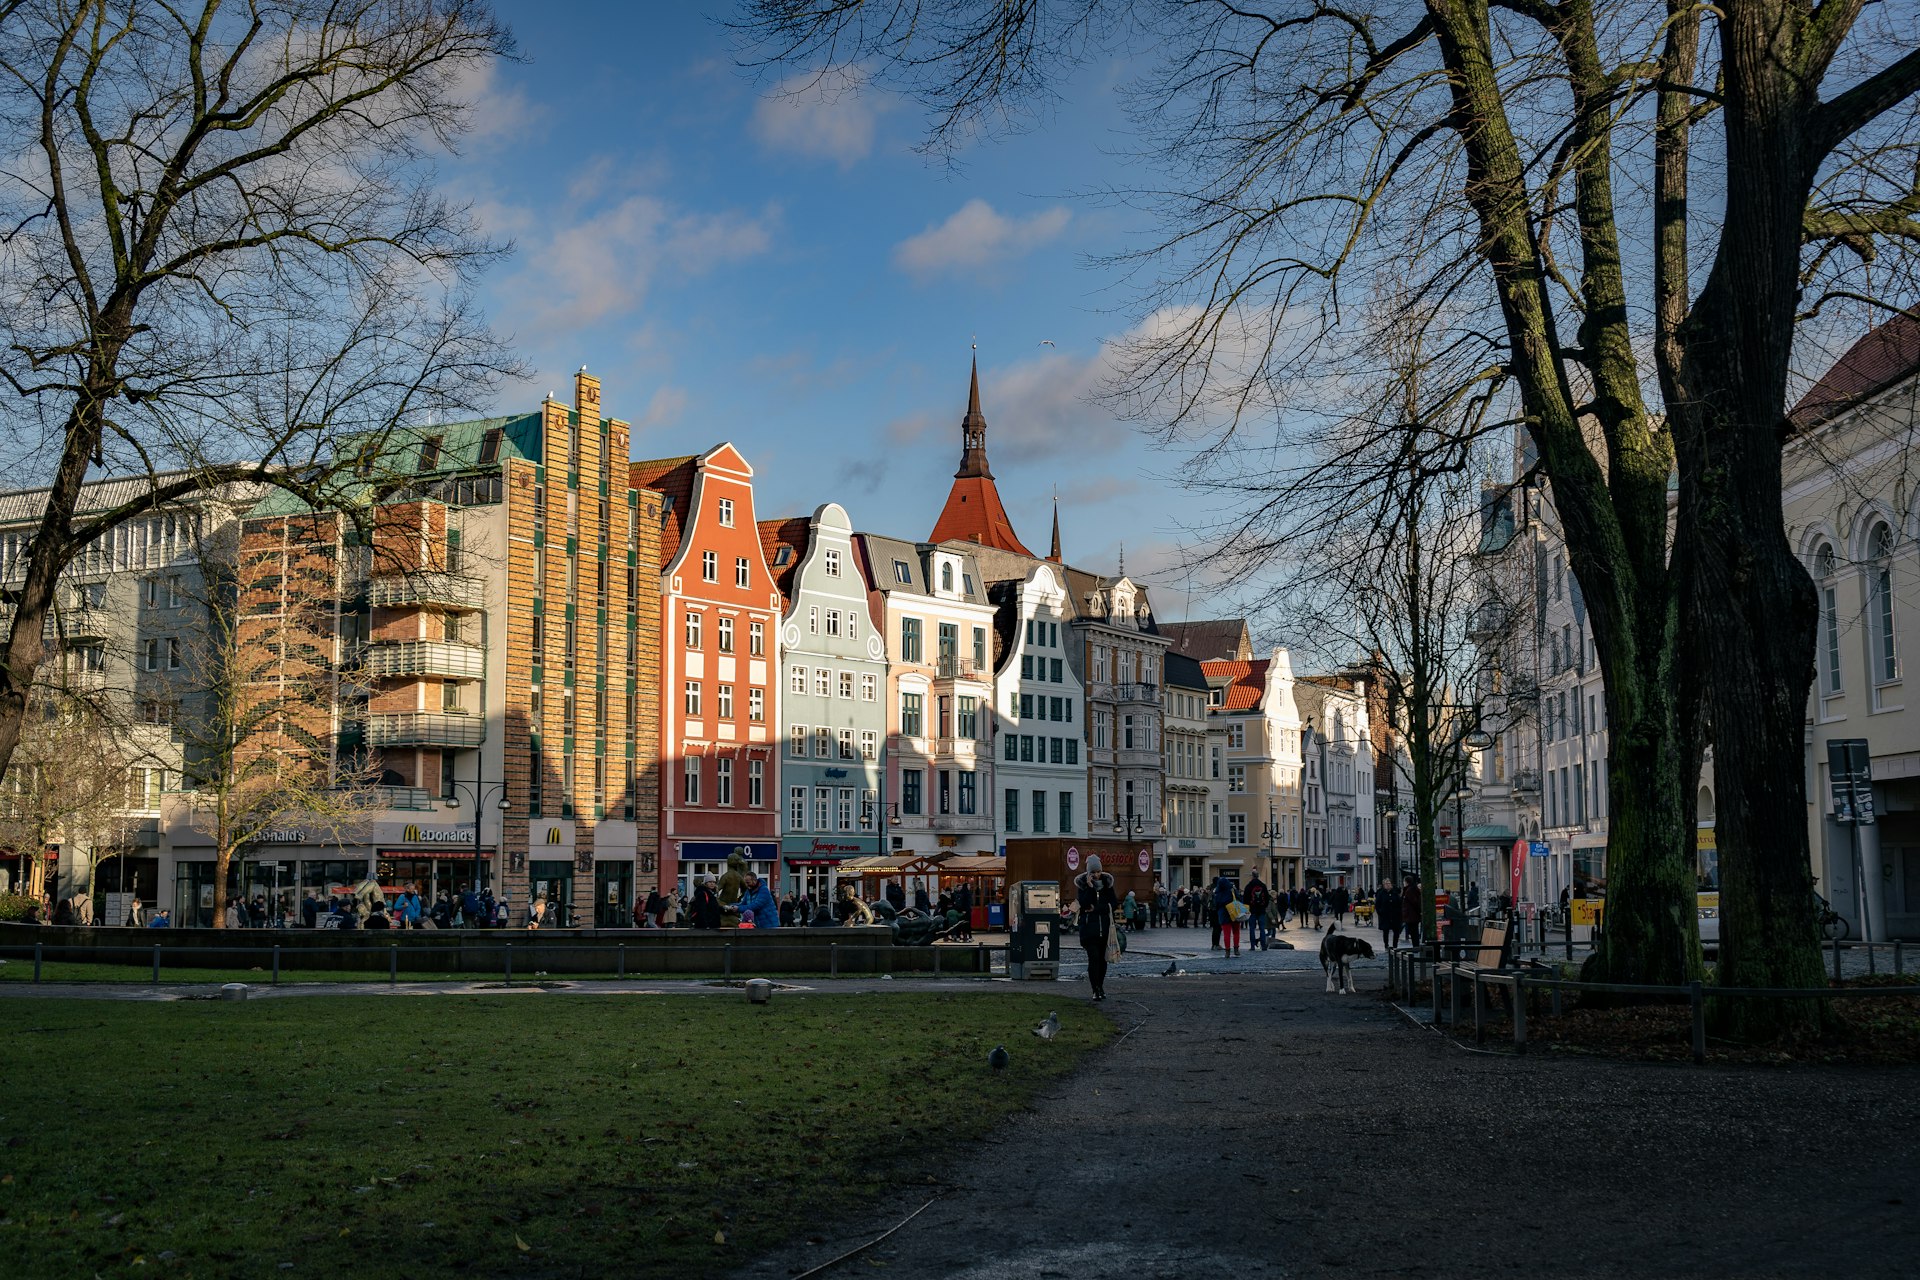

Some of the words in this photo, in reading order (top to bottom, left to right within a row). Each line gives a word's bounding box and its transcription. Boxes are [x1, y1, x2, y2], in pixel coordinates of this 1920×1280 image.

[403, 824, 474, 842] McDonald's
[809, 838, 838, 857] Junge
[1100, 849, 1134, 865] Rostock
